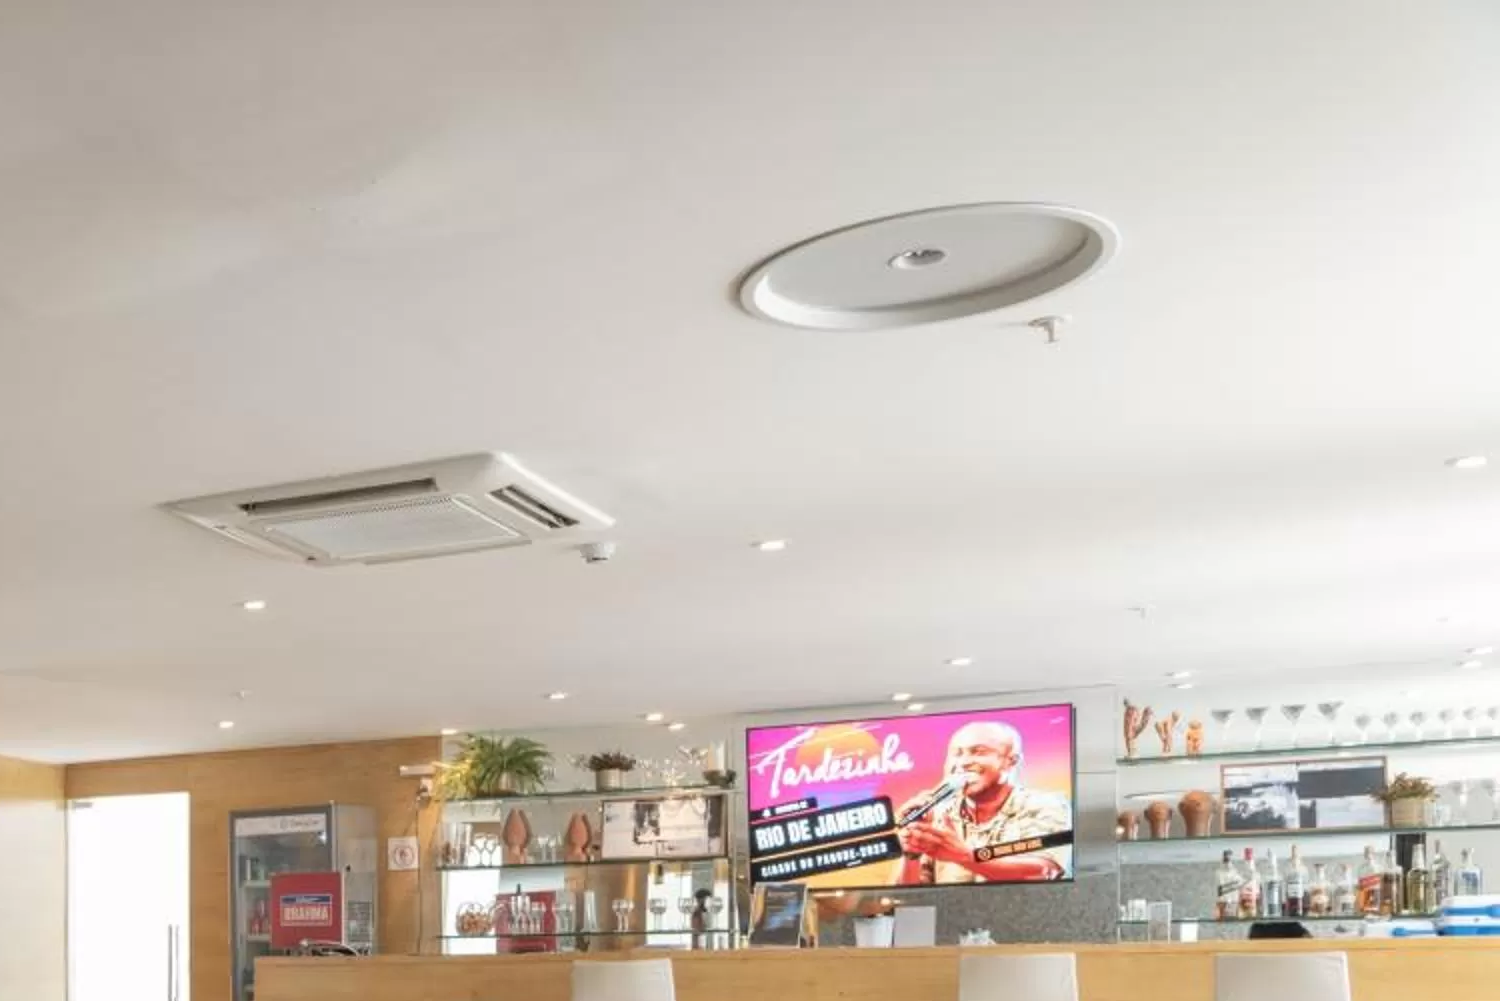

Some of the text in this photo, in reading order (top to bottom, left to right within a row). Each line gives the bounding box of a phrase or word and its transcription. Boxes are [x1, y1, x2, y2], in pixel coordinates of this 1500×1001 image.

[754, 824, 786, 850] RIO
[787, 818, 813, 844] DE
[814, 802, 889, 838] JANEIRO
